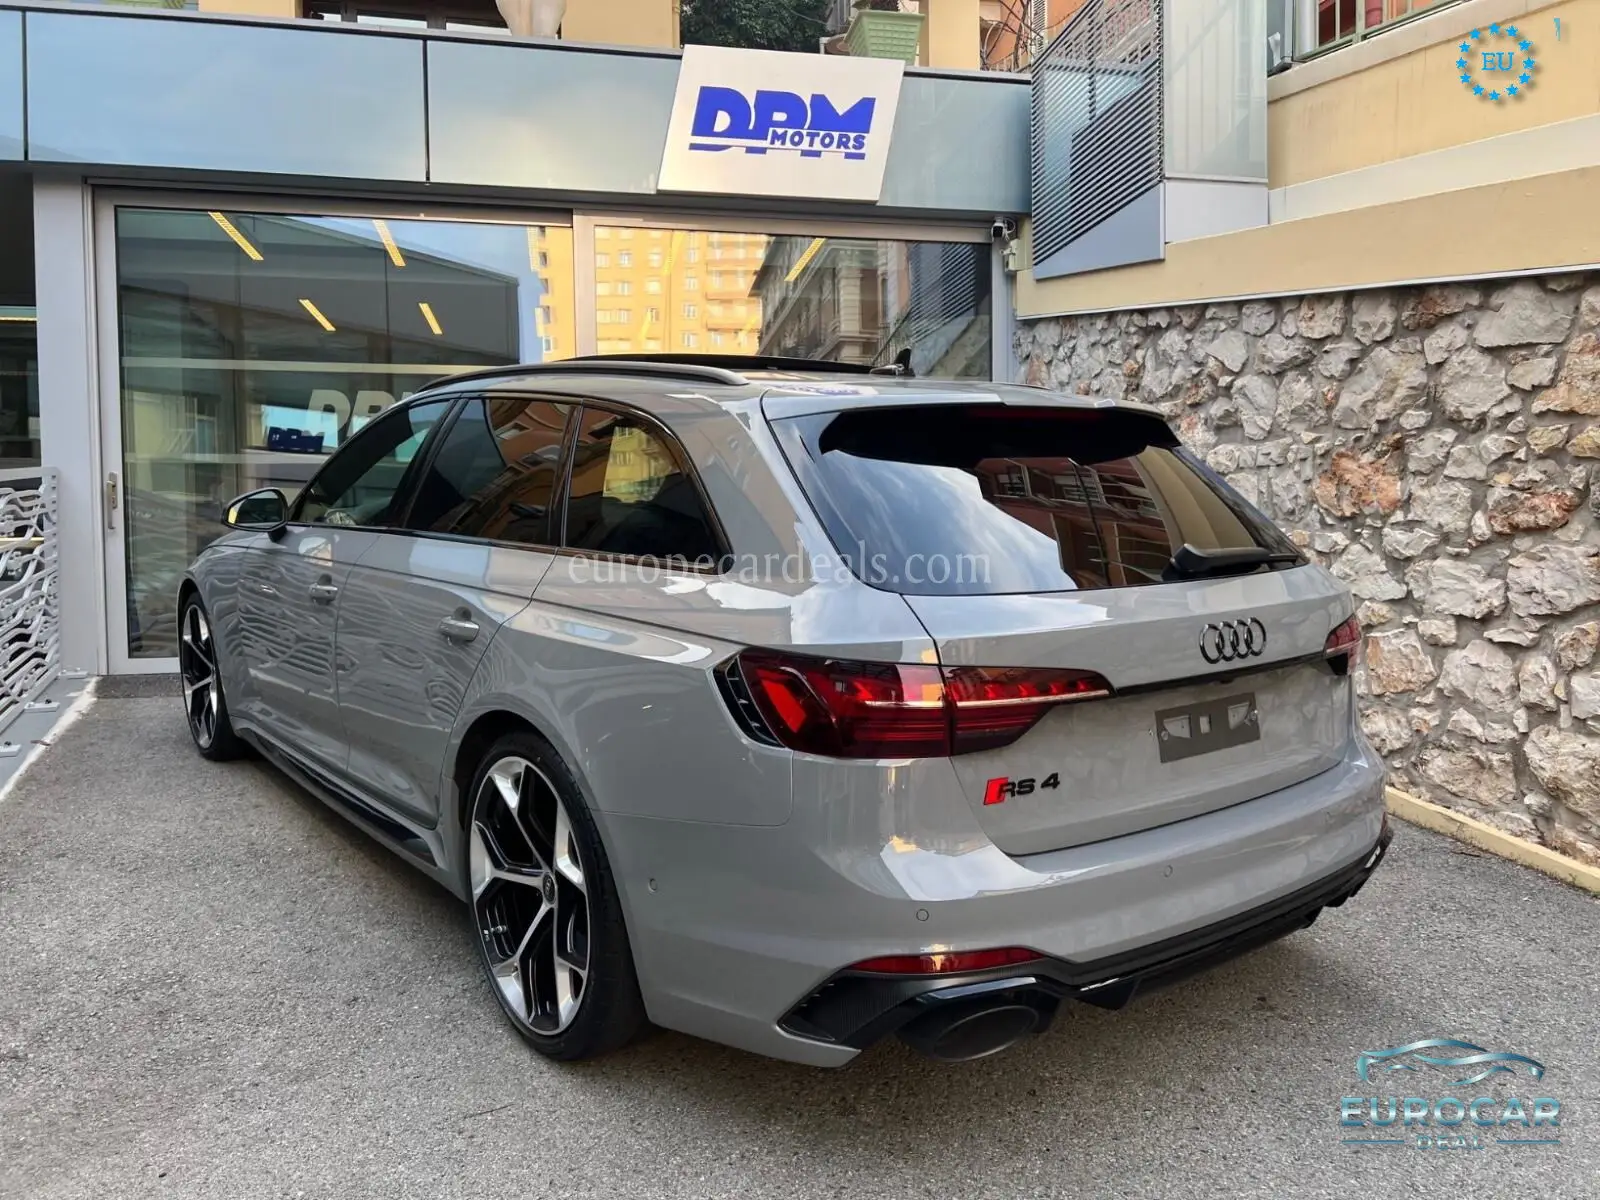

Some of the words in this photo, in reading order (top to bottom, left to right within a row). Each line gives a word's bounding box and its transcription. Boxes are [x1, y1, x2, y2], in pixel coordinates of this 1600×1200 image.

[689, 86, 876, 160] DPM
[769, 130, 866, 150] MOTORS
[306, 389, 414, 438] DP
[997, 778, 1036, 800] RS
[1040, 772, 1061, 790] 4
